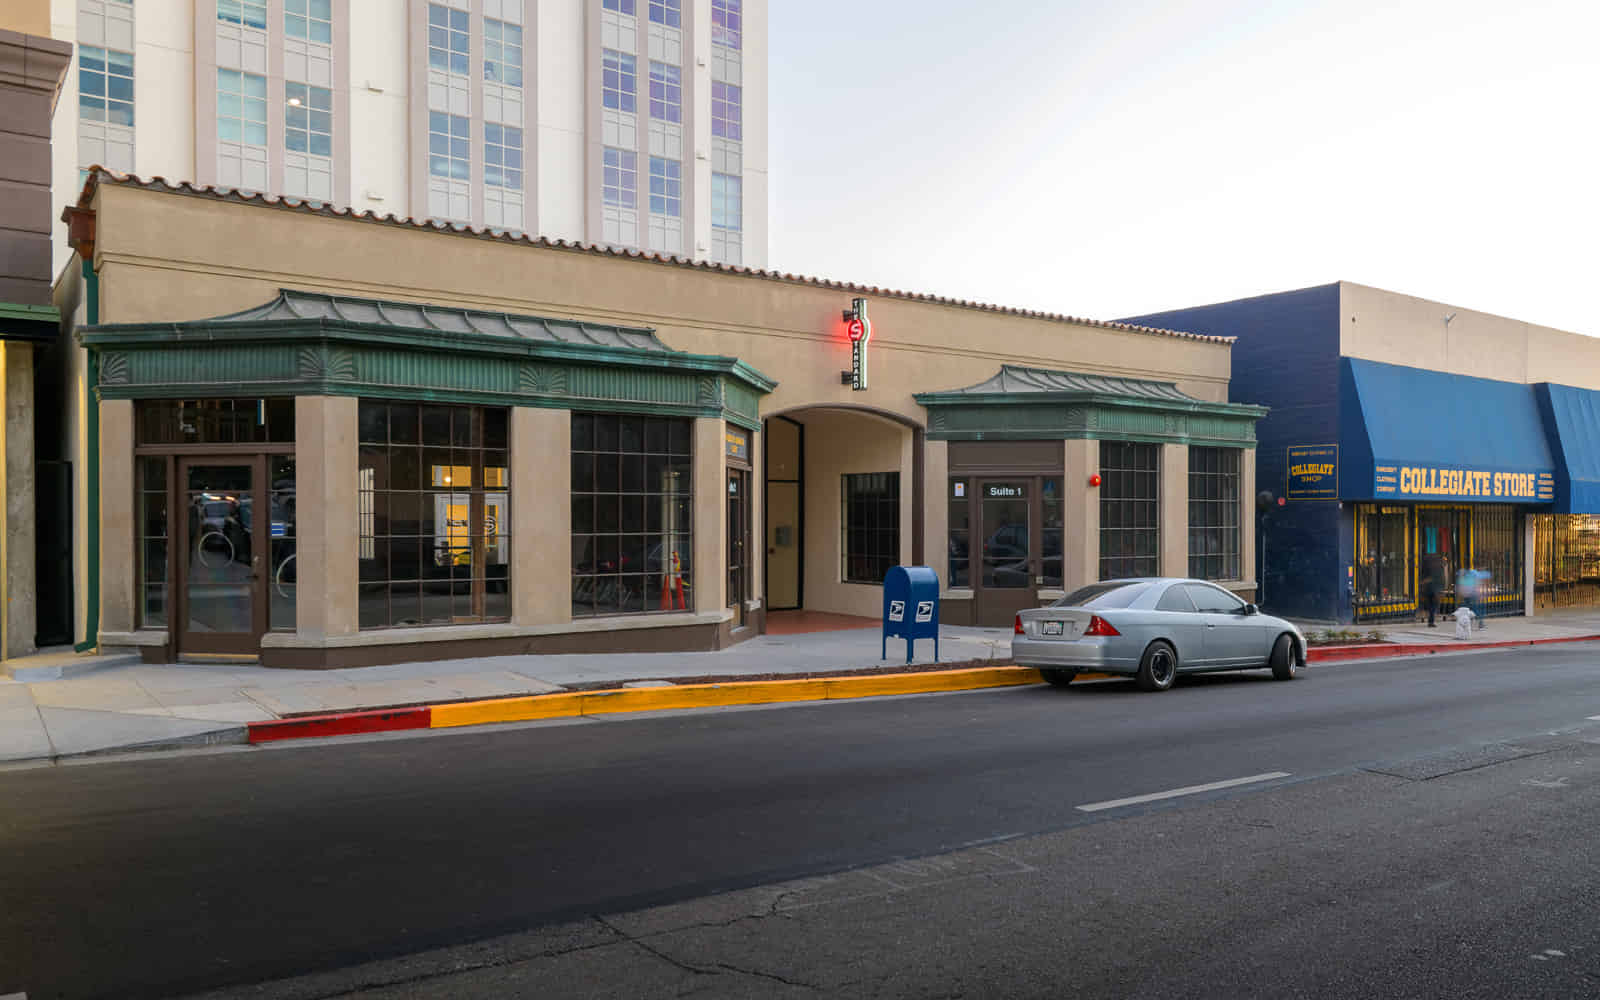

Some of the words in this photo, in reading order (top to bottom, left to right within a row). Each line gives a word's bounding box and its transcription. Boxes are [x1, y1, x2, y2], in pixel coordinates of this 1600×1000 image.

[1291, 463, 1334, 476] COLLEGIATE
[1400, 467, 1491, 496] COLLEGIATE
[1494, 472, 1535, 497] STORE
[990, 487, 1014, 496] Suite
